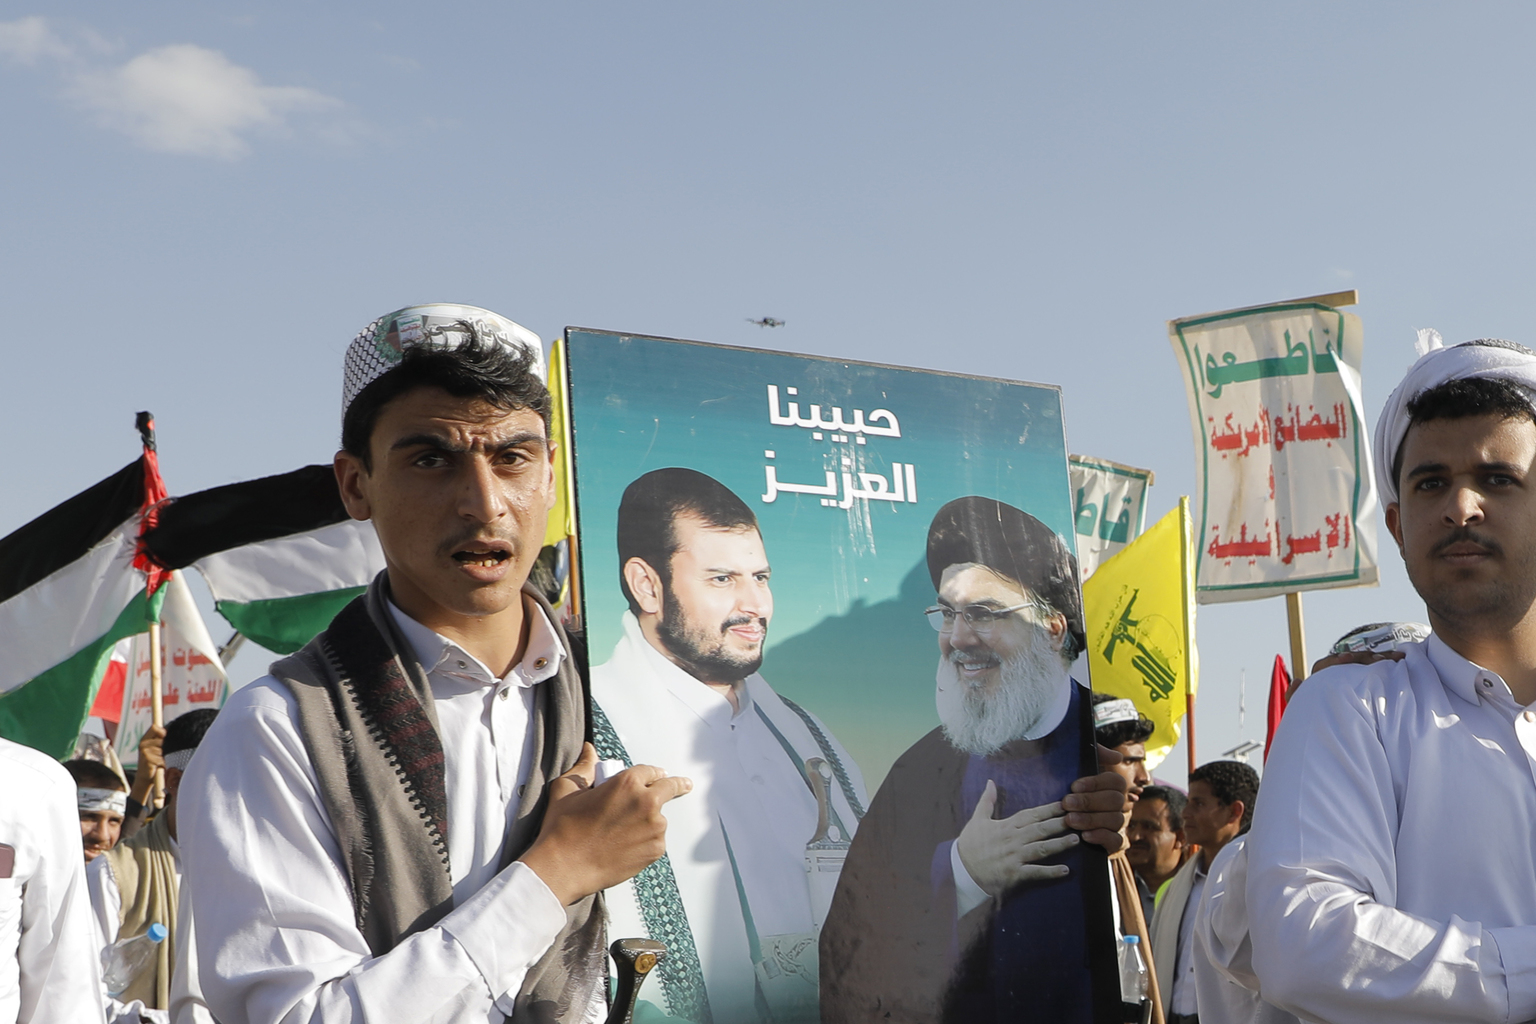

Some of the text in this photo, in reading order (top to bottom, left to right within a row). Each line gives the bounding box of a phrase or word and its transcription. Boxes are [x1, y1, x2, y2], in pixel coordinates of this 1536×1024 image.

[767, 384, 902, 445] حبيبنا
[1274, 402, 1347, 452] البضائع
[761, 449, 918, 510] العزيز
[1075, 486, 1133, 544] قاط
[1207, 512, 1350, 567] الإسرائيلية
